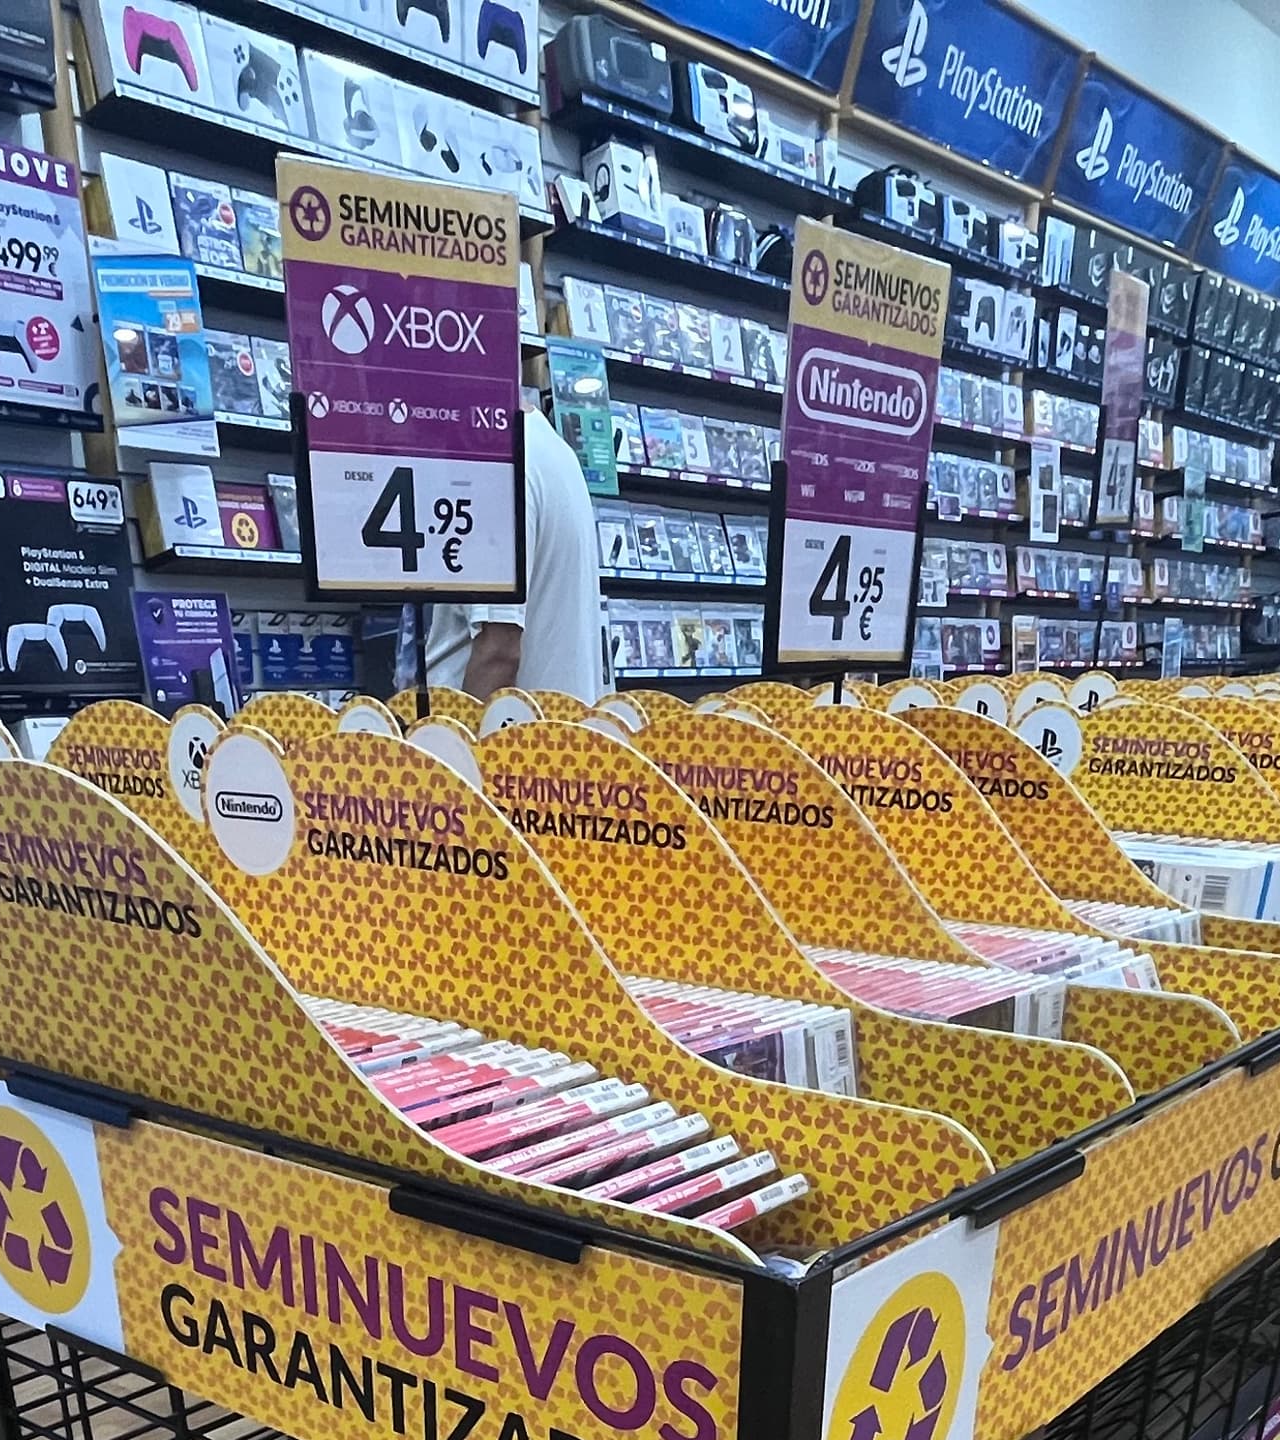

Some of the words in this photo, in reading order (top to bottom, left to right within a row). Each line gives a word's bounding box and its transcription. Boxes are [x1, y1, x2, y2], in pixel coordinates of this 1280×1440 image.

[938, 43, 1043, 137] PlayStation
[1116, 143, 1193, 210] PlayStation
[339, 193, 506, 242] SEMINUEVOS
[340, 224, 507, 266] GARANTIZADOS
[833, 257, 941, 315] SEMINUEVOS
[383, 303, 488, 355] XBOX
[831, 291, 938, 338] GARANTIZADOS
[809, 365, 917, 420] Nintendo
[72, 486, 108, 509] 649
[344, 470, 374, 482] DESDE
[361, 465, 426, 573] 4
[21, 546, 76, 561] PlayStation
[23, 561, 61, 575] DIGITAL
[809, 534, 852, 642] 4
[65, 745, 162, 771] SEMINUEVOS
[817, 754, 923, 783] MINUEVOS
[1092, 735, 1212, 760] SEMINUEVOS
[493, 773, 649, 812] SEMINUEVOS
[1088, 757, 1237, 784] GARANTIZADOS
[221, 796, 277, 817] Nintendo
[303, 791, 468, 837] SEMINUEVOS
[687, 793, 834, 829] ANTIZADOS
[307, 829, 510, 882] GARANTIZADOS
[1002, 1132, 1269, 1374] SEMINUEVOS
